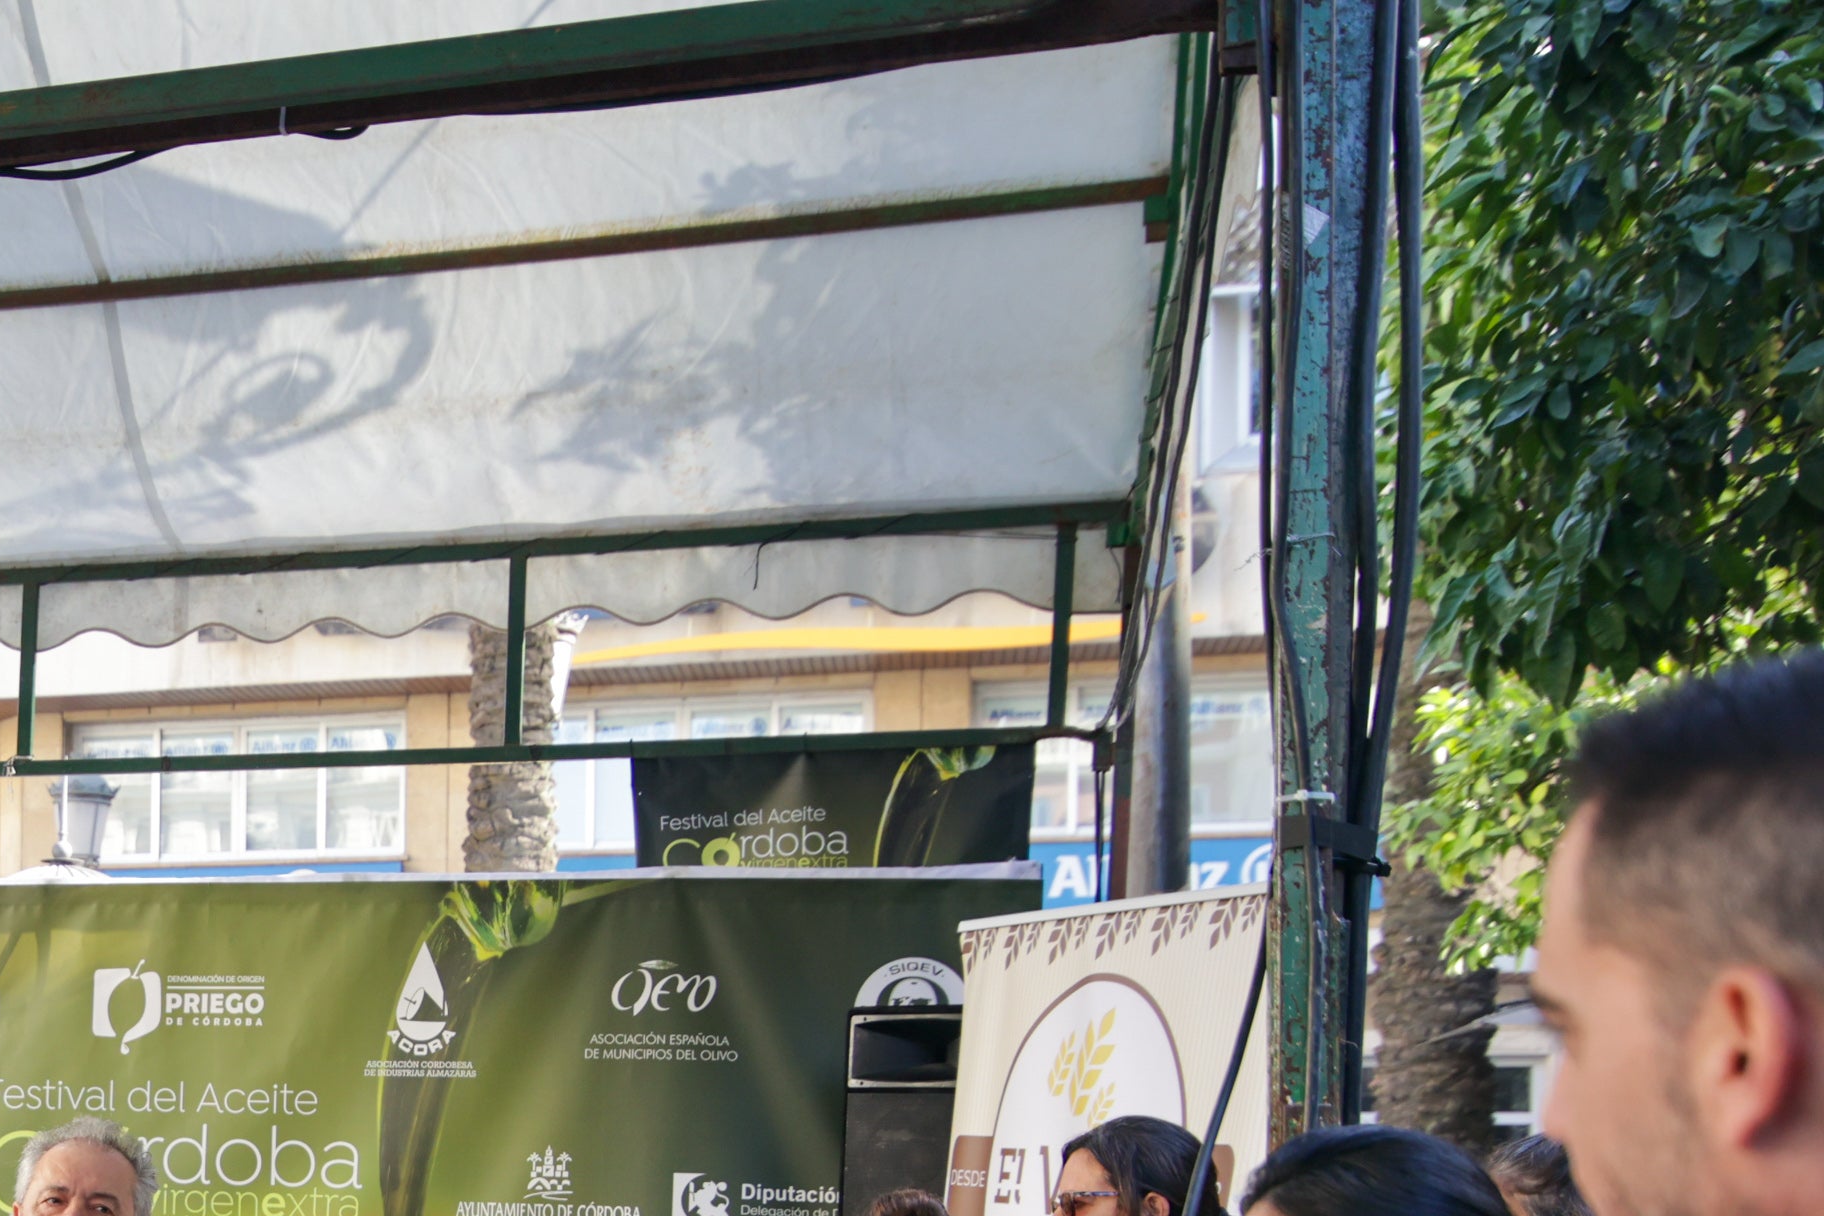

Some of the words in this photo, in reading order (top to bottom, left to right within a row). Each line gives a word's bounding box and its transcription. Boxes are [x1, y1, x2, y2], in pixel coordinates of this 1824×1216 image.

[660, 811, 728, 831] Festival
[733, 809, 763, 826] del
[767, 806, 826, 824] Aceite
[662, 825, 849, 866] Córdoba
[889, 961, 943, 976] SIQEV
[167, 974, 225, 983] DENOMINACIÓN
[226, 975, 236, 983] DE
[237, 975, 265, 983] ORIGEN
[165, 992, 265, 1014] PRIEGO
[166, 1017, 183, 1026] DE
[192, 1015, 263, 1026] CÓRDOBA
[386, 1029, 456, 1056] ACORA
[589, 1031, 666, 1045] ASOCIACIÓN
[669, 1032, 730, 1046] ESPAÑOLA
[584, 1048, 599, 1059] DE
[602, 1049, 672, 1060] MUNICIPIOS
[676, 1050, 696, 1061] DEL
[700, 1050, 739, 1062] OLIVO
[366, 1058, 419, 1068] ASOCIACIÓN
[420, 1060, 473, 1069] CORDOBESA
[364, 1069, 376, 1077] DE
[377, 1069, 425, 1077] INDUSTRIAS
[426, 1070, 477, 1078] ALMAZARAS
[127, 1080, 185, 1114] del
[196, 1082, 319, 1116] Aceite
[951, 1169, 986, 1188] DESDE
